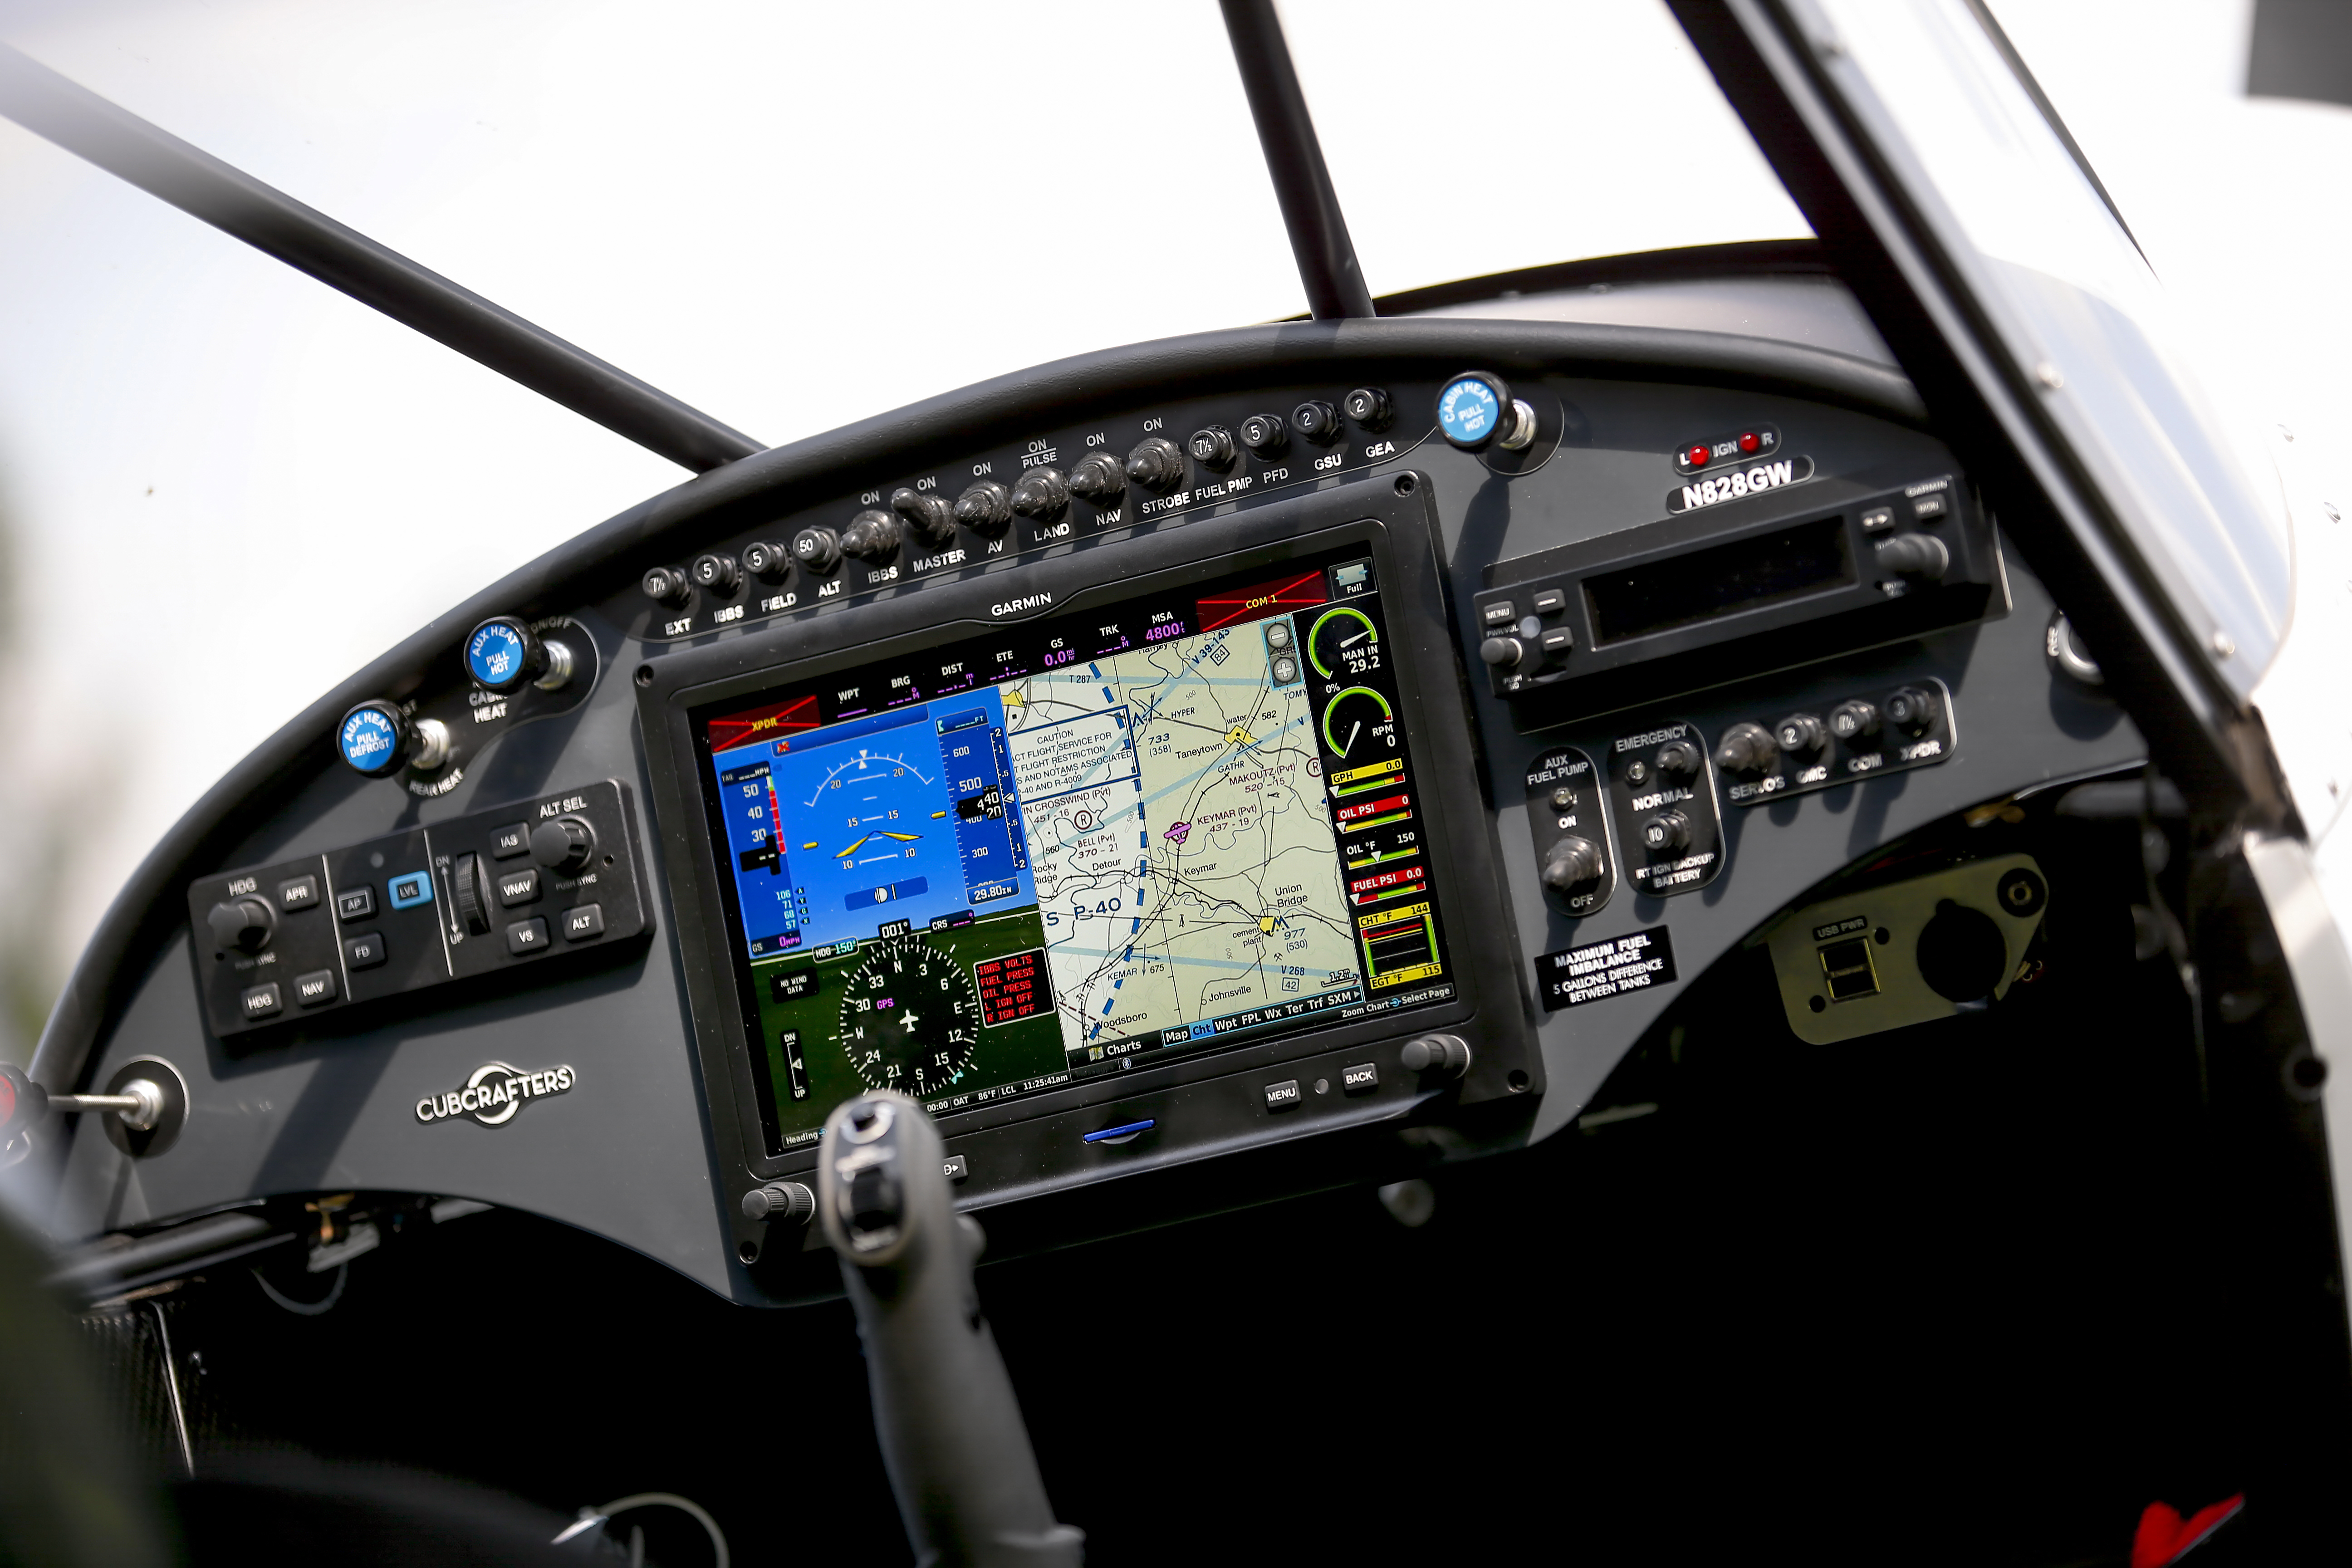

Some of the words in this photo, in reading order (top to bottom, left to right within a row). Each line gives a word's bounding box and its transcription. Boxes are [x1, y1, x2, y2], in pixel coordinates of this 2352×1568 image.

[1458, 403, 1485, 422] PULL
[1143, 418, 1163, 432] ON
[1464, 416, 1485, 433] HOT
[1028, 439, 1047, 453] ON
[1086, 433, 1105, 447] ON
[1365, 441, 1396, 458] GEA
[1713, 441, 1738, 458] IGN
[1022, 452, 1058, 469] PULSE
[1314, 454, 1342, 471] GSU
[973, 462, 991, 476] ON
[1263, 468, 1288, 484] PFD
[917, 476, 936, 490] ON
[1196, 484, 1225, 500] FUEL
[1228, 476, 1253, 493] PMP
[1681, 459, 1793, 510] N828GW
[862, 490, 880, 505] ON
[1142, 491, 1191, 514] STROBE
[1096, 509, 1122, 526] NAV
[1034, 523, 1070, 541] LAND
[988, 540, 1003, 554] AV
[913, 549, 966, 572] MASTER
[867, 566, 898, 584] IBBS
[818, 580, 841, 598] ALT
[1347, 583, 1362, 593] Full
[761, 593, 797, 612] FIELD
[991, 592, 1052, 616] GARMIN
[1245, 596, 1268, 609] COM
[714, 605, 745, 623] IBBS
[1152, 612, 1173, 624] MSA
[665, 617, 691, 636] EXT
[1099, 625, 1119, 637] TRK
[490, 626, 519, 647] HEAT
[1051, 638, 1063, 648] GS
[485, 650, 510, 667] PULL
[996, 650, 1014, 662] ETE
[1343, 649, 1365, 662] MAN
[490, 660, 509, 676] HOT
[941, 662, 963, 676] DIST
[1349, 655, 1380, 673] 29.2
[891, 676, 911, 688] BRG
[838, 687, 859, 701] WPT
[473, 702, 507, 724] HEAT
[1171, 707, 1196, 719] HYPER
[1227, 713, 1247, 725] water
[1262, 710, 1277, 720] 582
[364, 712, 392, 734] HEAT
[752, 717, 777, 731] XPDR
[1372, 724, 1393, 737] RPM
[357, 730, 379, 745] PULL
[1037, 729, 1073, 744] CAUTION
[1148, 733, 1170, 745] 733
[1616, 725, 1687, 752] EMERGENCY
[350, 738, 390, 759] DEFROST
[953, 746, 970, 758] 600
[1028, 745, 1055, 759] FLIGHT
[1058, 736, 1093, 751] SERVICE
[1095, 731, 1112, 743] FOR
[1149, 744, 1171, 758] (358)
[1176, 742, 1223, 760] Taneytown
[1021, 759, 1049, 772] FLIGHT
[1052, 745, 1106, 764] RESTRICTION
[1025, 773, 1042, 783] AND
[1044, 764, 1079, 778] NOTAMS
[1081, 750, 1132, 769] ASSOCIATED
[1545, 755, 1568, 769] AUX
[1848, 754, 1882, 771] COM
[1218, 760, 1245, 774] GATHR
[1333, 771, 1353, 783] GPH
[1386, 760, 1401, 770] 0.0
[1528, 771, 1556, 785] FUEL
[1558, 761, 1588, 778] PUMP
[959, 777, 982, 793] 500
[1036, 782, 1053, 792] AND
[1055, 774, 1082, 786] R-4009
[540, 803, 560, 818] ALT
[564, 796, 588, 813] SEL
[1035, 792, 1089, 812] CROSSWIND
[1632, 788, 1694, 812] NORMAL
[1197, 809, 1236, 825] KEYMAR
[1238, 804, 1258, 817] (Pvt)
[1339, 808, 1356, 819] OIL
[1358, 804, 1375, 814] PSI
[1558, 815, 1577, 828] ON
[500, 834, 519, 848] IAS
[1347, 845, 1363, 855] OIL
[1397, 833, 1415, 844] 150
[971, 846, 989, 859] 300
[1092, 858, 1122, 871] Detour
[1184, 862, 1217, 876] Keymar
[1636, 867, 1651, 879] RT
[1652, 861, 1671, 874] IGN
[1674, 853, 1714, 870] BACKUP
[1353, 879, 1378, 892] FUEL
[1380, 874, 1396, 885] PSI
[1406, 868, 1422, 879] 0.0
[1653, 868, 1701, 888] BATTERY
[228, 877, 257, 897] HDG
[400, 883, 418, 897] LVL
[503, 879, 531, 897] VNAV
[1275, 883, 1303, 897] Union
[347, 897, 362, 911] AP
[1277, 894, 1308, 909] Bridge
[1571, 895, 1593, 907] OFF
[572, 915, 590, 930] ALT
[1360, 915, 1380, 926] CHT
[1411, 904, 1428, 915] 144
[932, 919, 948, 930] CRS
[1232, 926, 1260, 939] cement
[1817, 925, 1839, 938] USB
[1841, 919, 1865, 932] PWR
[518, 930, 534, 943] VS
[1284, 928, 1306, 940] 977
[355, 945, 370, 959] FD
[1286, 940, 1308, 953] (530)
[1554, 943, 1614, 968] MAXIMUM
[1618, 935, 1651, 952] FUEL
[1568, 949, 1641, 976] IMBALANCE
[1006, 967, 1034, 981] PRESS
[1107, 967, 1137, 981] KEMAR
[1372, 977, 1390, 988] EGT
[1423, 965, 1439, 976] 115
[1562, 972, 1606, 993] GALLONS
[1608, 957, 1663, 981] DIFFERENCE
[302, 980, 324, 997] NAV
[1003, 980, 1031, 994] PRESS
[1208, 985, 1251, 1002] Johnsville
[1569, 983, 1616, 1003] BETWEEN
[1618, 974, 1651, 991] TANKS
[247, 993, 273, 1010] HDG
[1401, 991, 1427, 1004] Select
[1428, 987, 1450, 1002] Page
[877, 998, 894, 1010] GPS
[1341, 1006, 1364, 1019] Zoom
[1366, 1000, 1390, 1014] Chart
[1094, 1012, 1147, 1029] Woodsboro
[1166, 1030, 1188, 1043] Map
[1193, 1025, 1211, 1035] Cht
[1215, 1017, 1237, 1031] Wpt
[1242, 1012, 1261, 1024] FPL
[1264, 1008, 1282, 1019] Wx
[1285, 1004, 1303, 1014] Ter
[1307, 998, 1323, 1010] Trf
[1328, 992, 1352, 1006] SXM
[1107, 1040, 1142, 1056] Charts
[1345, 1071, 1372, 1084] BACK
[416, 1068, 573, 1122] CUBCRAFTERS
[1001, 1085, 1016, 1095] LCL
[1267, 1087, 1296, 1103] MENU
[953, 1096, 969, 1107] OAT
[786, 1131, 818, 1145] Heading
